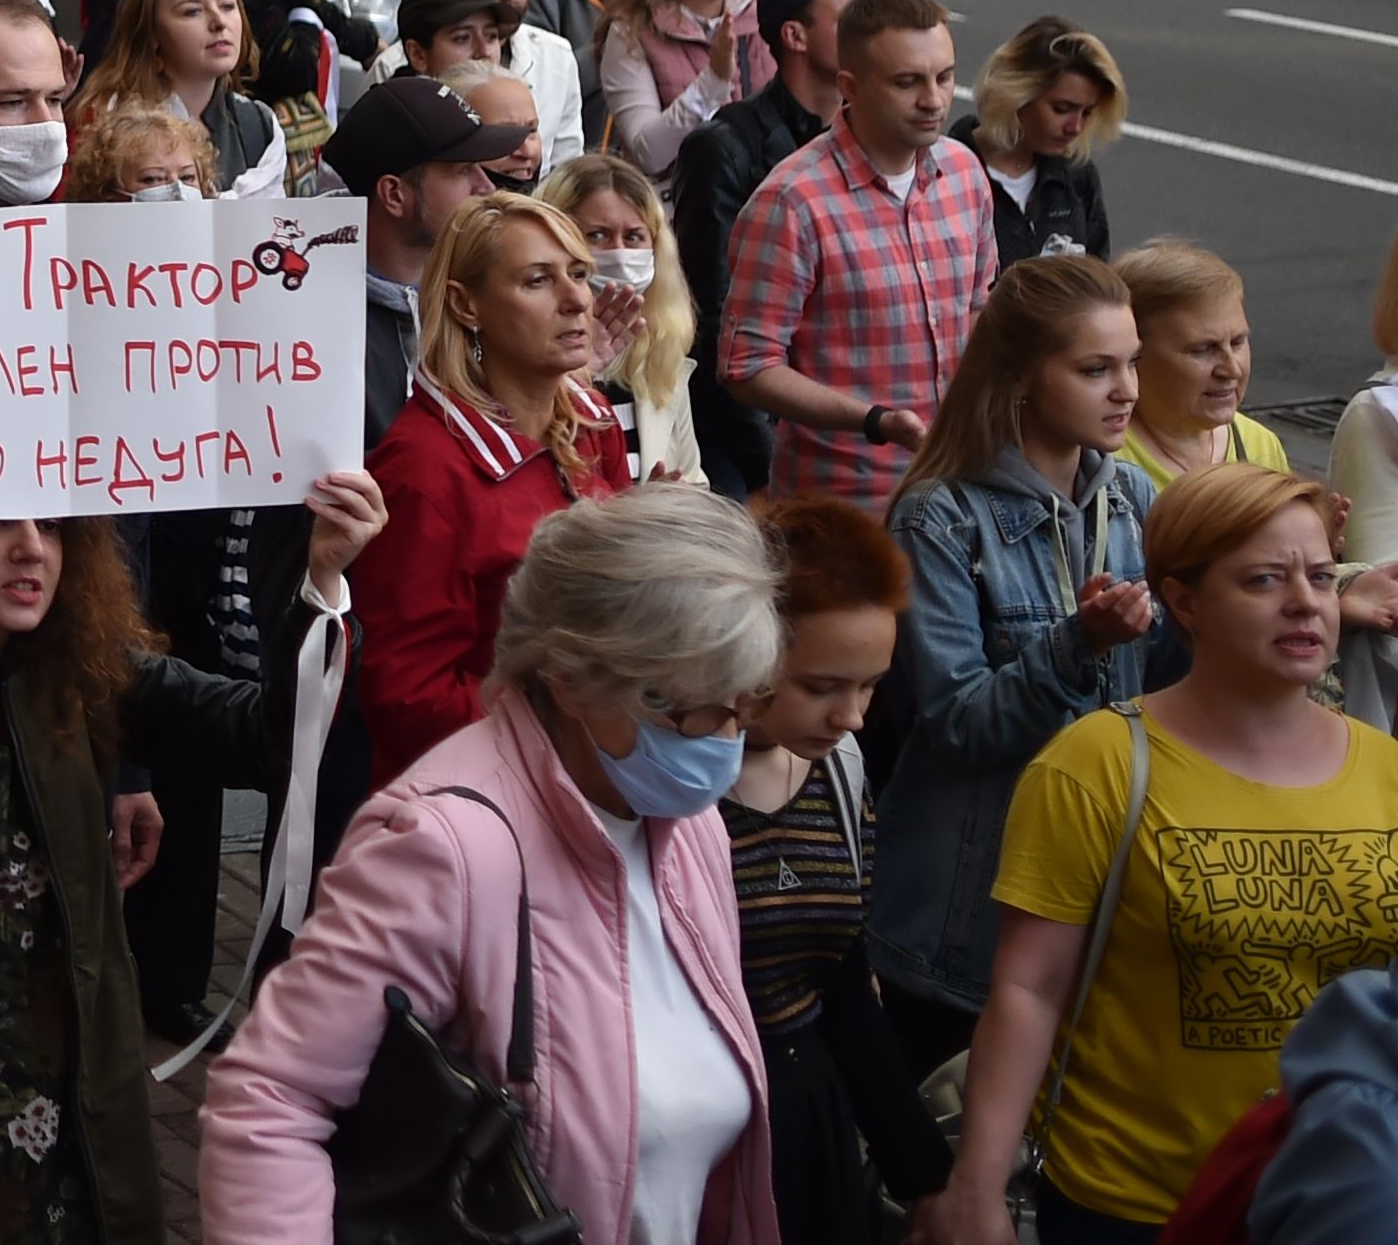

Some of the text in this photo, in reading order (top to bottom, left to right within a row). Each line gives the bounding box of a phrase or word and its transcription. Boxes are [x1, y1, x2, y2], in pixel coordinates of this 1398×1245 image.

[125, 339, 322, 393] ПРОТИВ
[36, 405, 283, 505] НЕДУГА!
[1190, 838, 1335, 878] LUNA
[1203, 877, 1345, 917] LUNA
[1187, 1025, 1282, 1045] A POETIC
